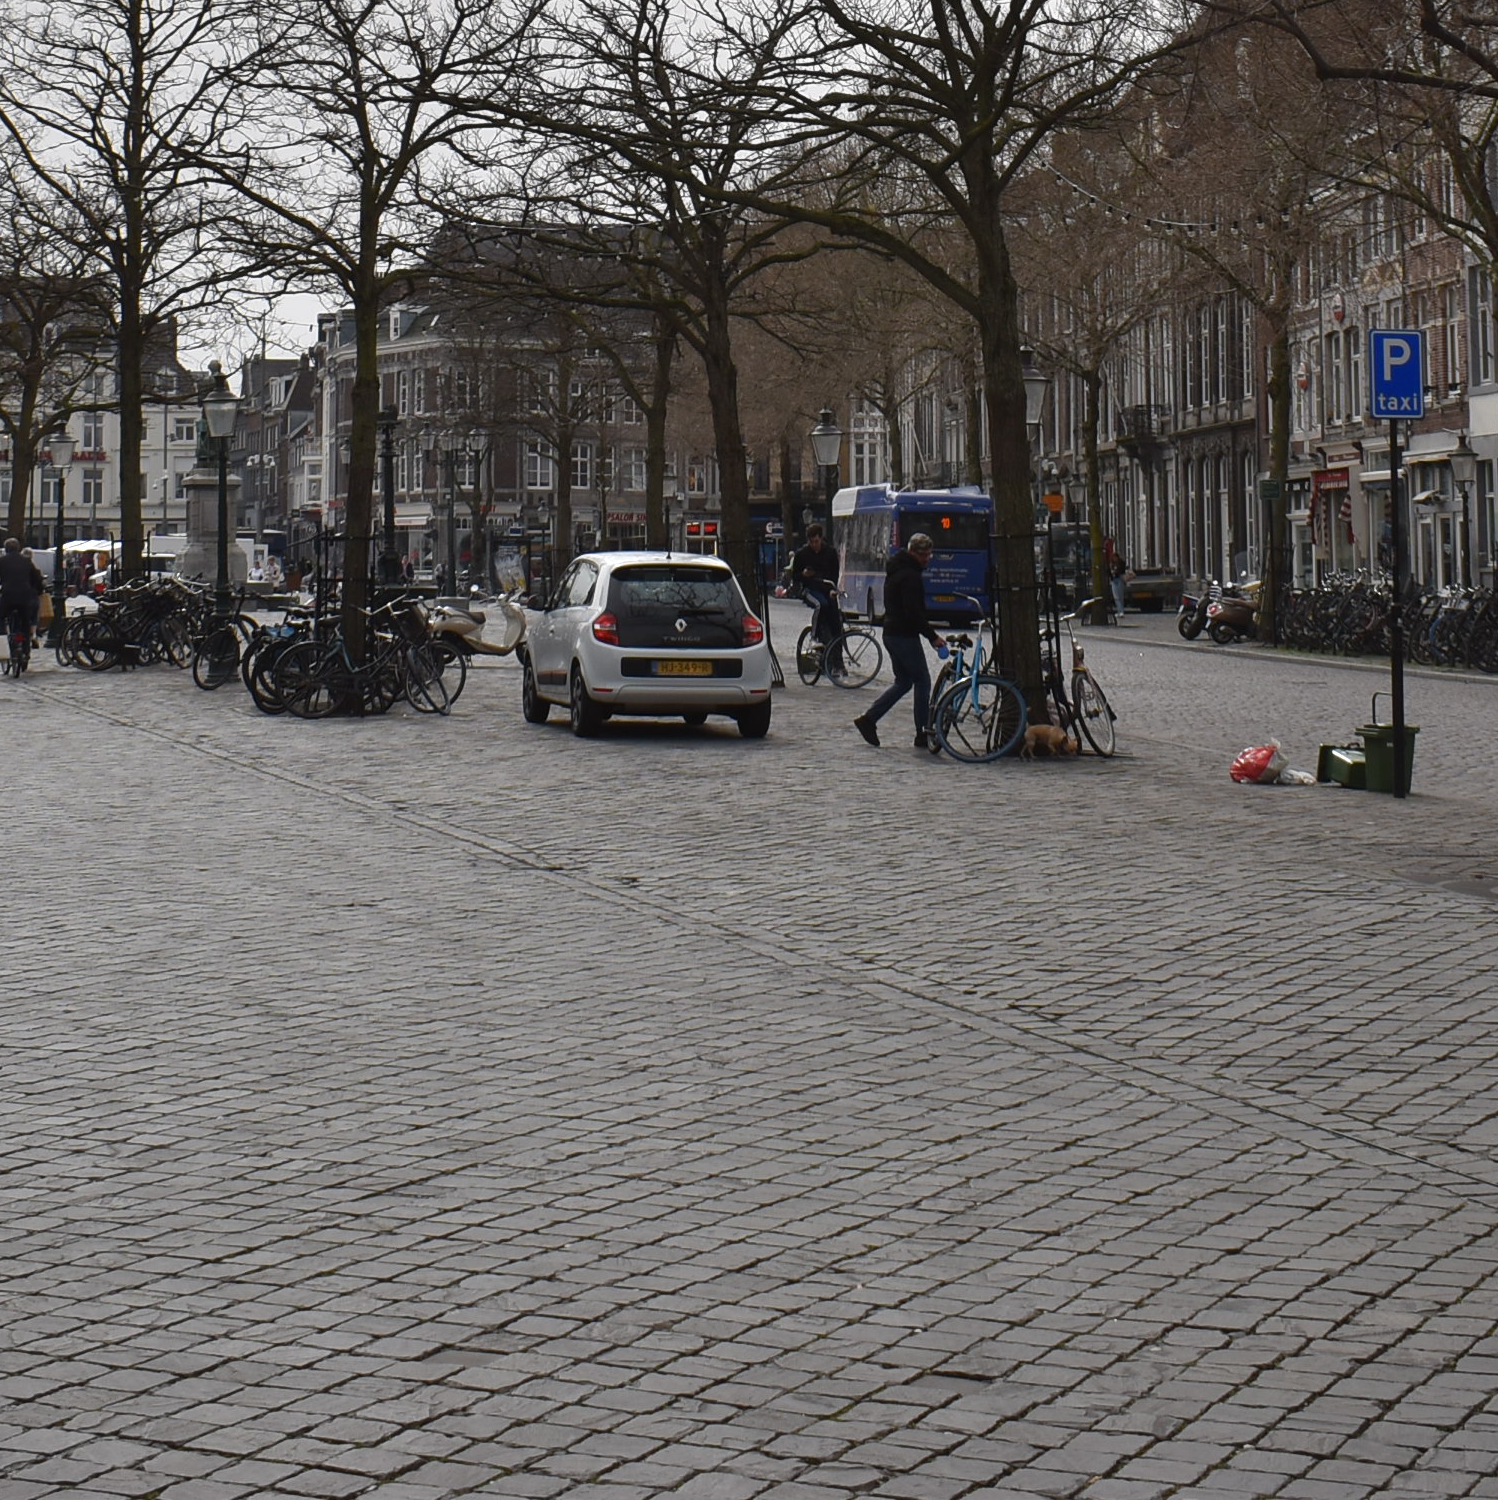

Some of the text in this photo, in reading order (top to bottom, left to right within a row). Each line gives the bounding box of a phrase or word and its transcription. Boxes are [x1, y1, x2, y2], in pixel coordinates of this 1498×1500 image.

[1383, 338, 1411, 381] P
[1378, 392, 1418, 411] taxi
[940, 516, 953, 530] 10
[662, 635, 701, 643] TWINGO
[661, 662, 709, 673] HJ-349-R
